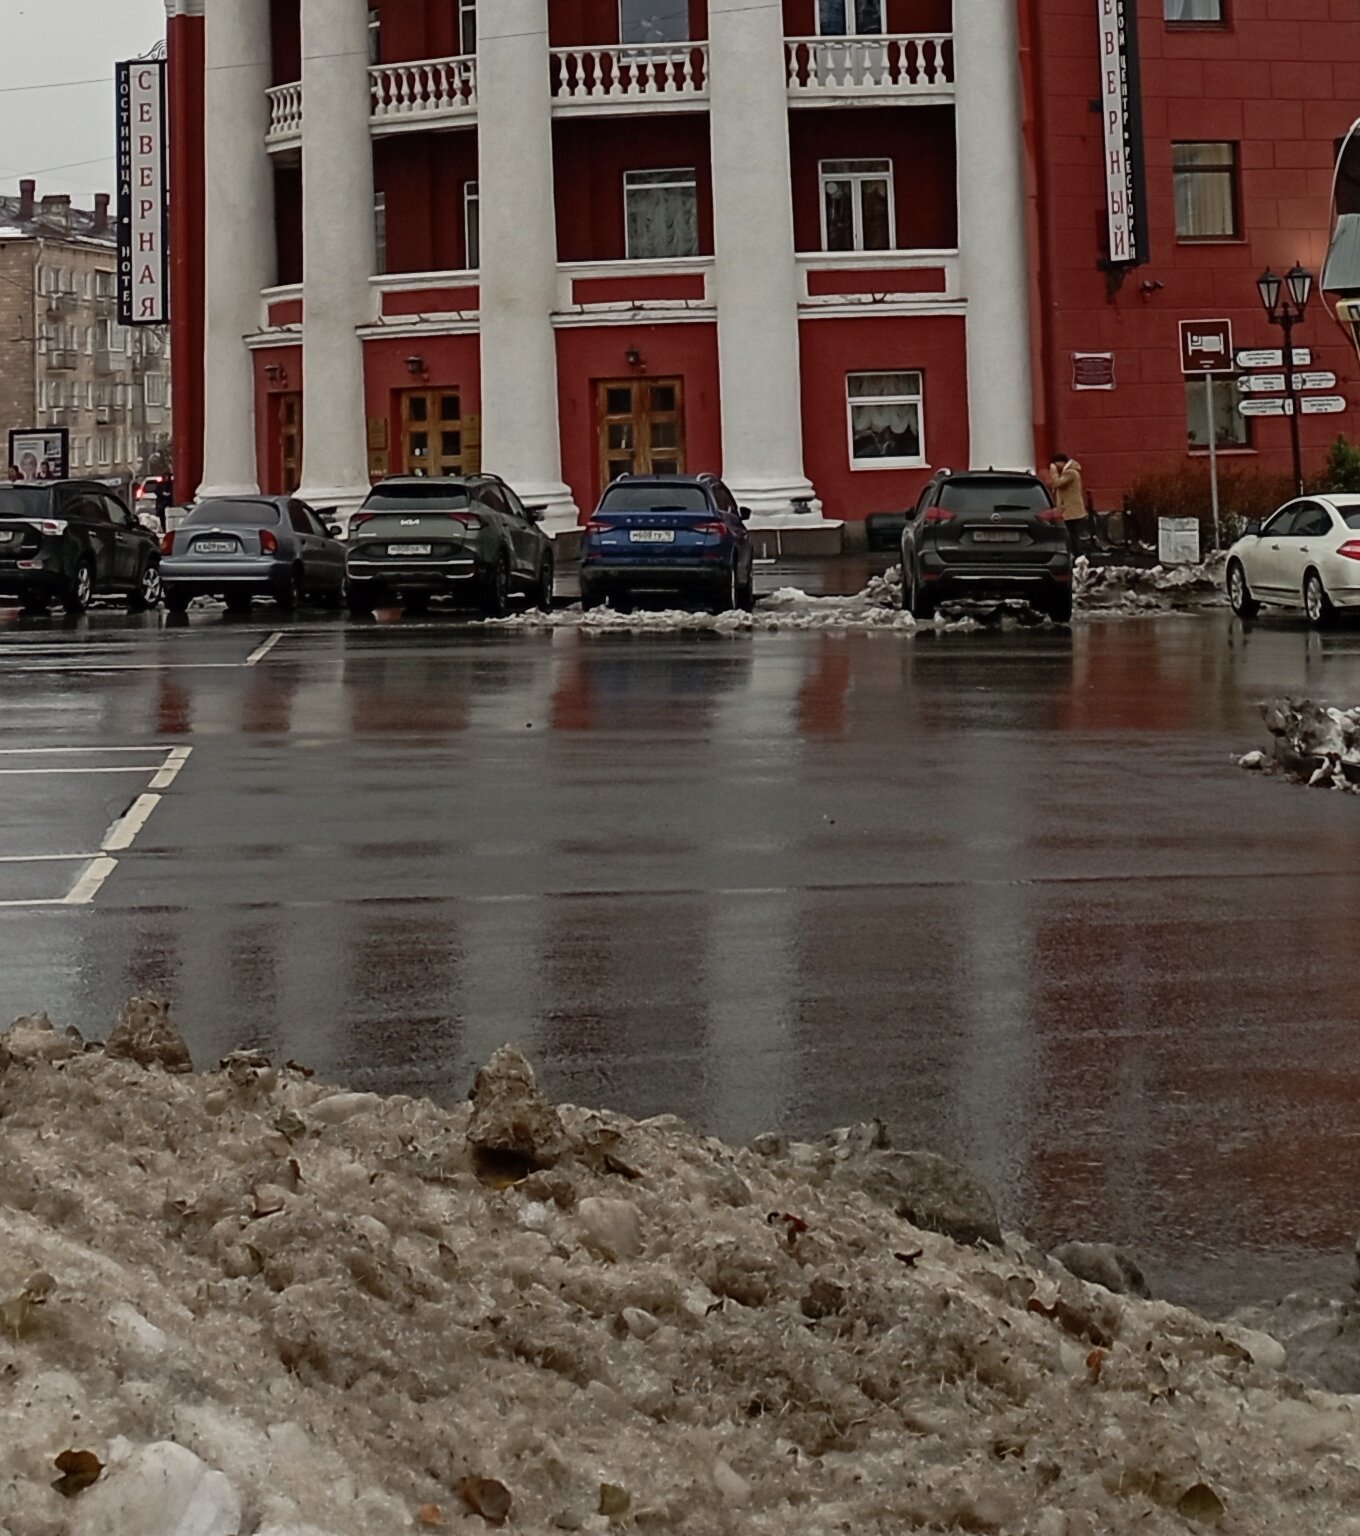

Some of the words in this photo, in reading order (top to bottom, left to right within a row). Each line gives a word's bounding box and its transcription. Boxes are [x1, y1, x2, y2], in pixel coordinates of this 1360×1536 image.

[120, 71, 130, 196] ГОСТИНИЦА
[1120, 55, 1129, 122] ЦЕНТР
[138, 70, 155, 317] СЕВЕРНАЯ
[1124, 147, 1137, 260] РЕСТОРАН
[122, 246, 131, 316] HOTEL
